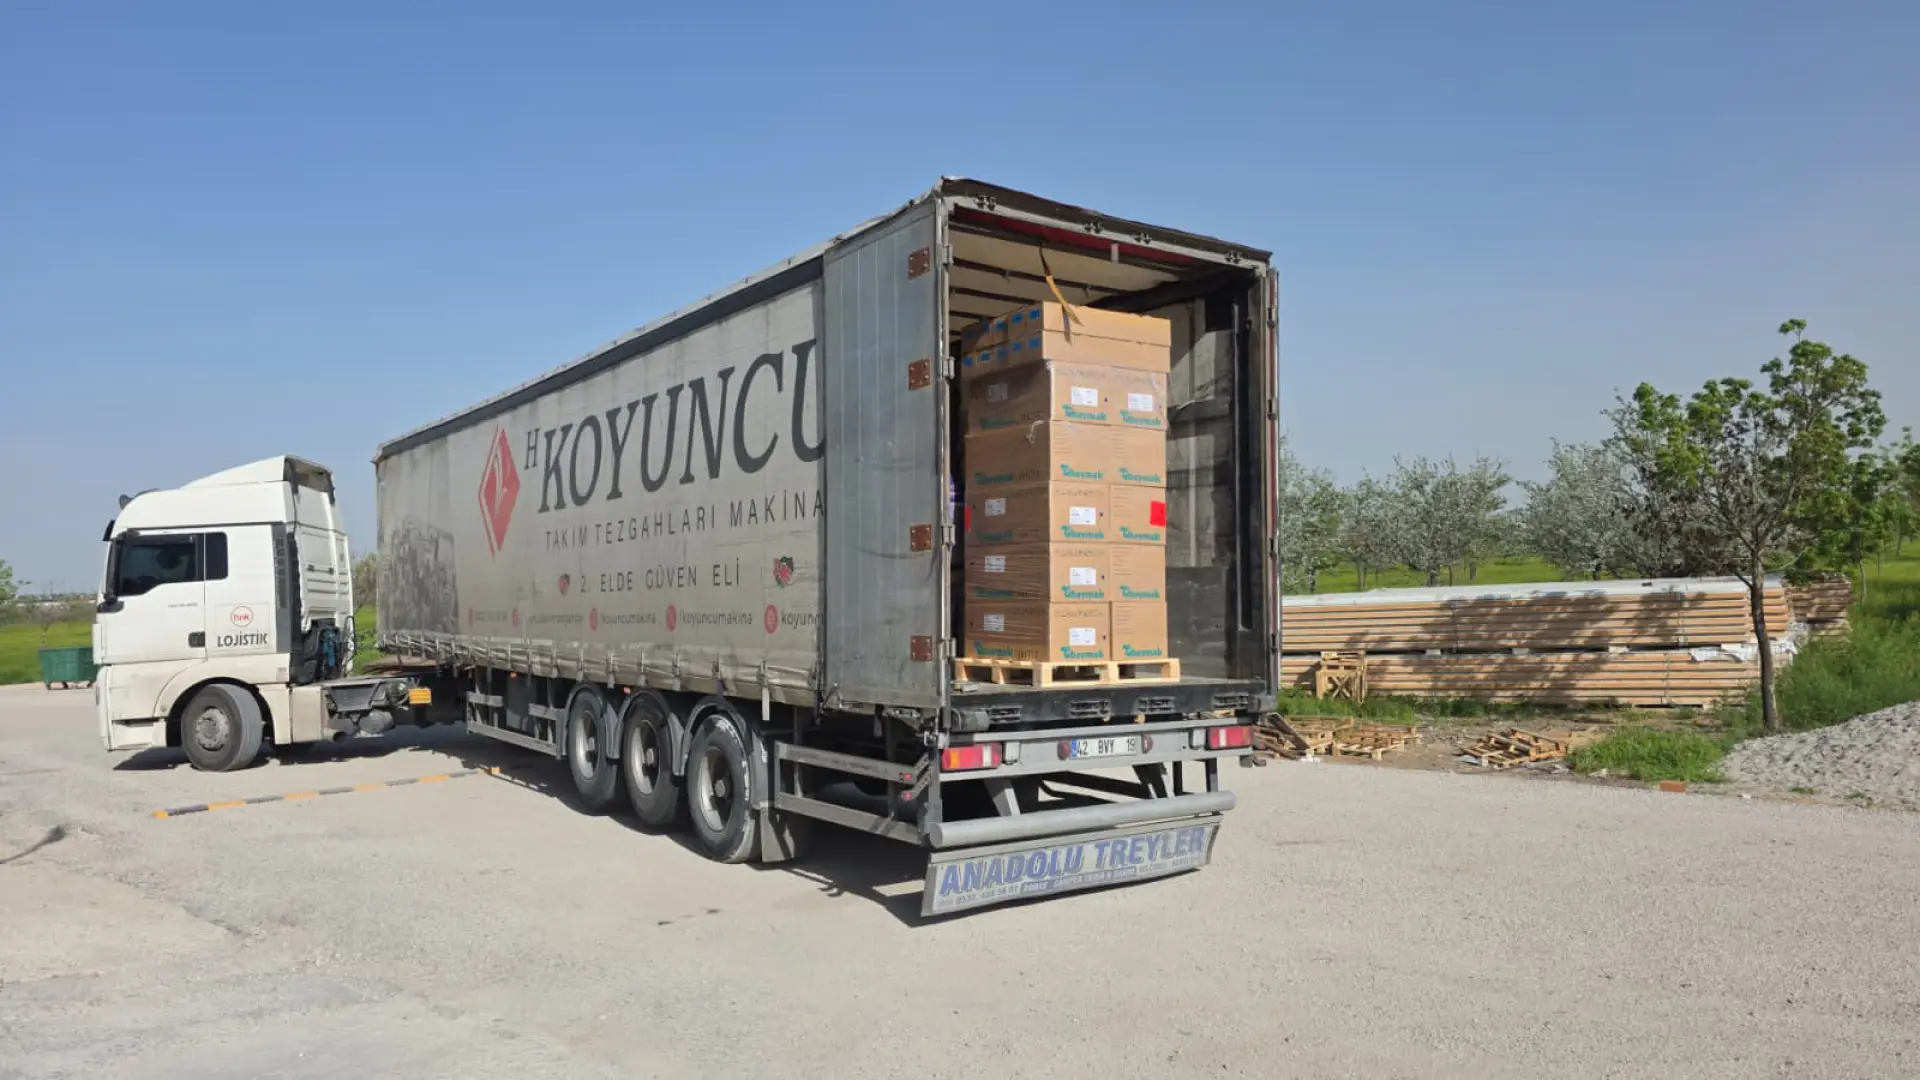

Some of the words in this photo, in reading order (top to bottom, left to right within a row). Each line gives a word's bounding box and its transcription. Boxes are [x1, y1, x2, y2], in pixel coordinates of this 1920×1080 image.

[545, 524, 588, 551] TAKIM
[595, 504, 715, 546] TEZGAHLARI
[730, 489, 824, 528] MAKİNA
[600, 570, 633, 592] ELDE
[645, 564, 698, 590] GÜVEN
[712, 556, 740, 587] ELİ
[217, 629, 268, 648] LOJİSTİK
[1077, 740, 1088, 756] 42
[939, 845, 1084, 897] ANADOLU
[1094, 826, 1206, 869] TREYLER
